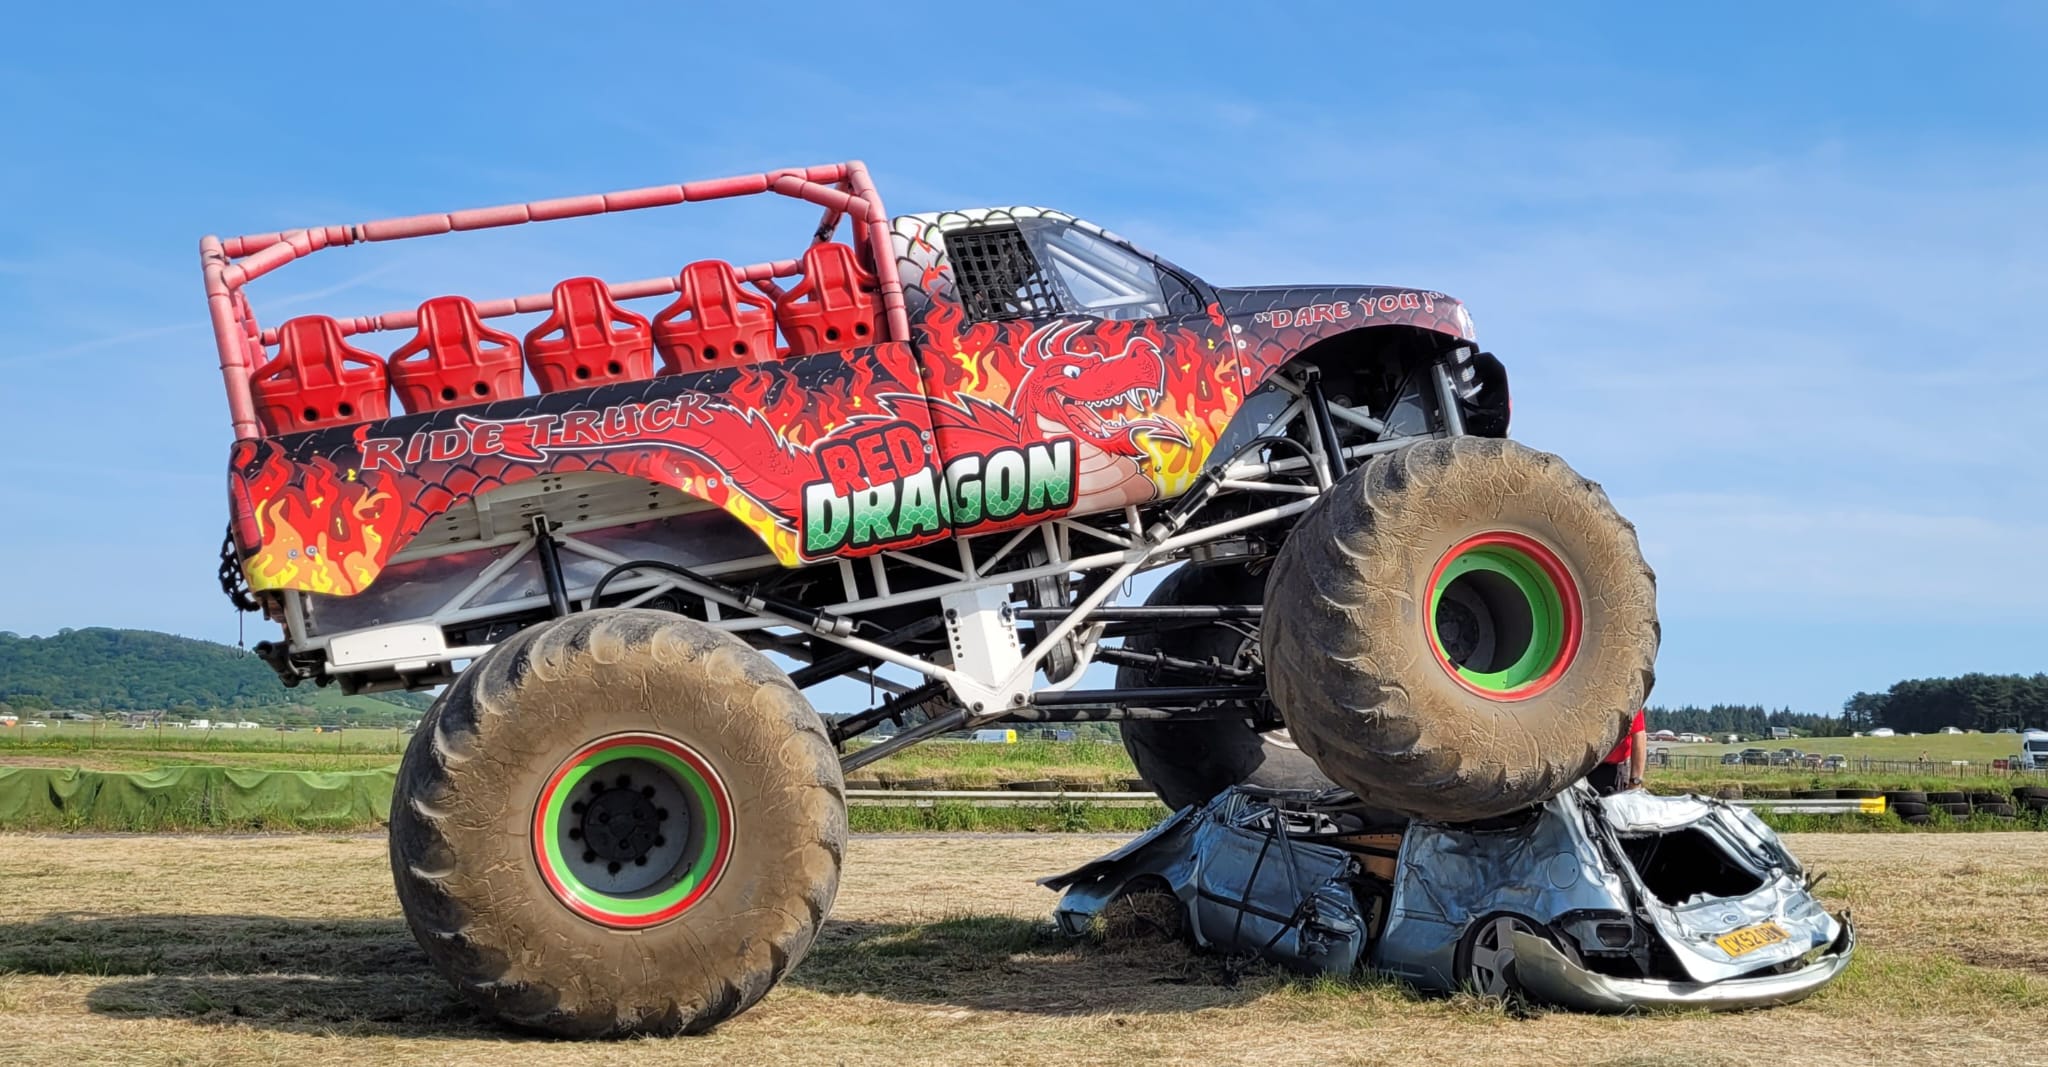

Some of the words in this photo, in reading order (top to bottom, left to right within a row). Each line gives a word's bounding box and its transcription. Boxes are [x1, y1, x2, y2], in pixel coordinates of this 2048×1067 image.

[360, 423, 503, 472] RIDE
[530, 393, 714, 448] TRUCK
[821, 427, 925, 498] RED
[806, 440, 1072, 552] DRAGON
